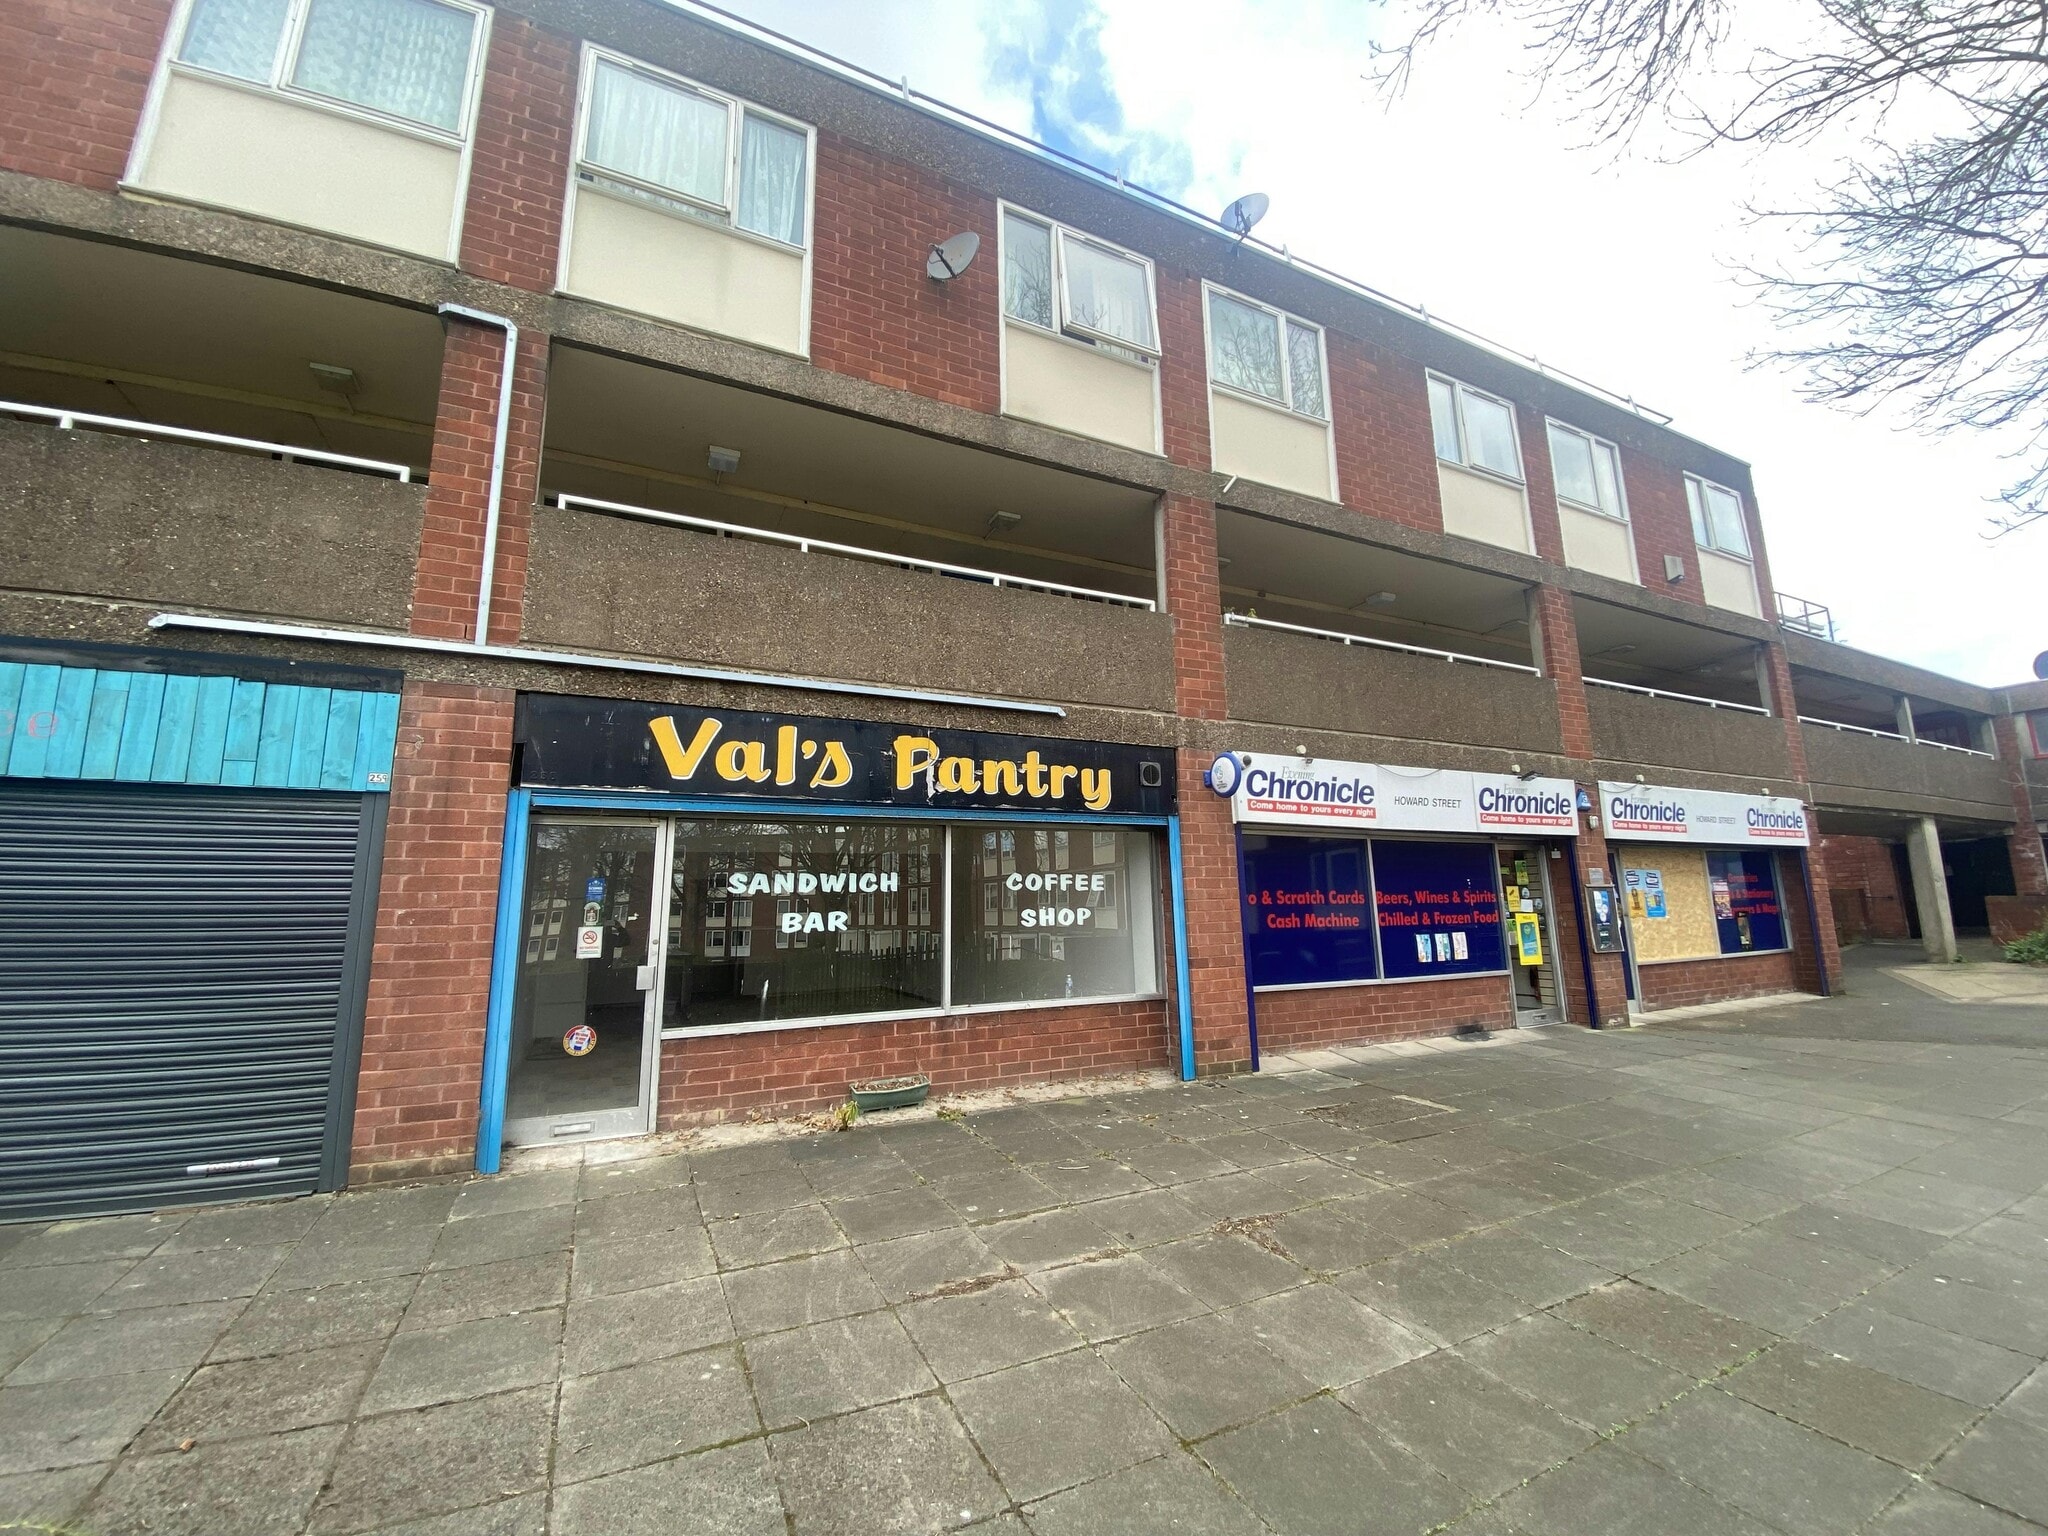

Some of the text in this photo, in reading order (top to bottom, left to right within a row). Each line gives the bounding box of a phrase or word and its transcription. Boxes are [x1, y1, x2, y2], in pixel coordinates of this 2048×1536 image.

[649, 716, 1112, 810] Val's Pantry
[1246, 769, 1375, 805] Chronicle
[1250, 800, 1374, 817] Come home to yours every night
[1394, 796, 1462, 808] HOWARD STREET
[1479, 787, 1571, 815] Chronicle
[1611, 797, 1685, 822] Chronicle
[1482, 814, 1499, 822] Come
[1500, 814, 1517, 823] home
[1525, 817, 1541, 825] yours
[1558, 817, 1571, 826] night
[1747, 808, 1803, 829] Chronicle
[727, 872, 898, 895] SANDWICH
[1006, 872, 1105, 891] COFFEE
[1261, 890, 1272, 904] &
[1276, 890, 1325, 905] Scratch
[1328, 890, 1365, 905] Cards
[1375, 890, 1413, 906] Beers,
[1415, 890, 1449, 904] Wines
[1452, 890, 1461, 903] &
[1463, 890, 1496, 906] Spirits
[781, 911, 849, 933] BAR
[1020, 906, 1092, 927] SHOP
[1267, 913, 1360, 928] Cash Machine
[1379, 910, 1499, 926] Chilled & Frozen Food
